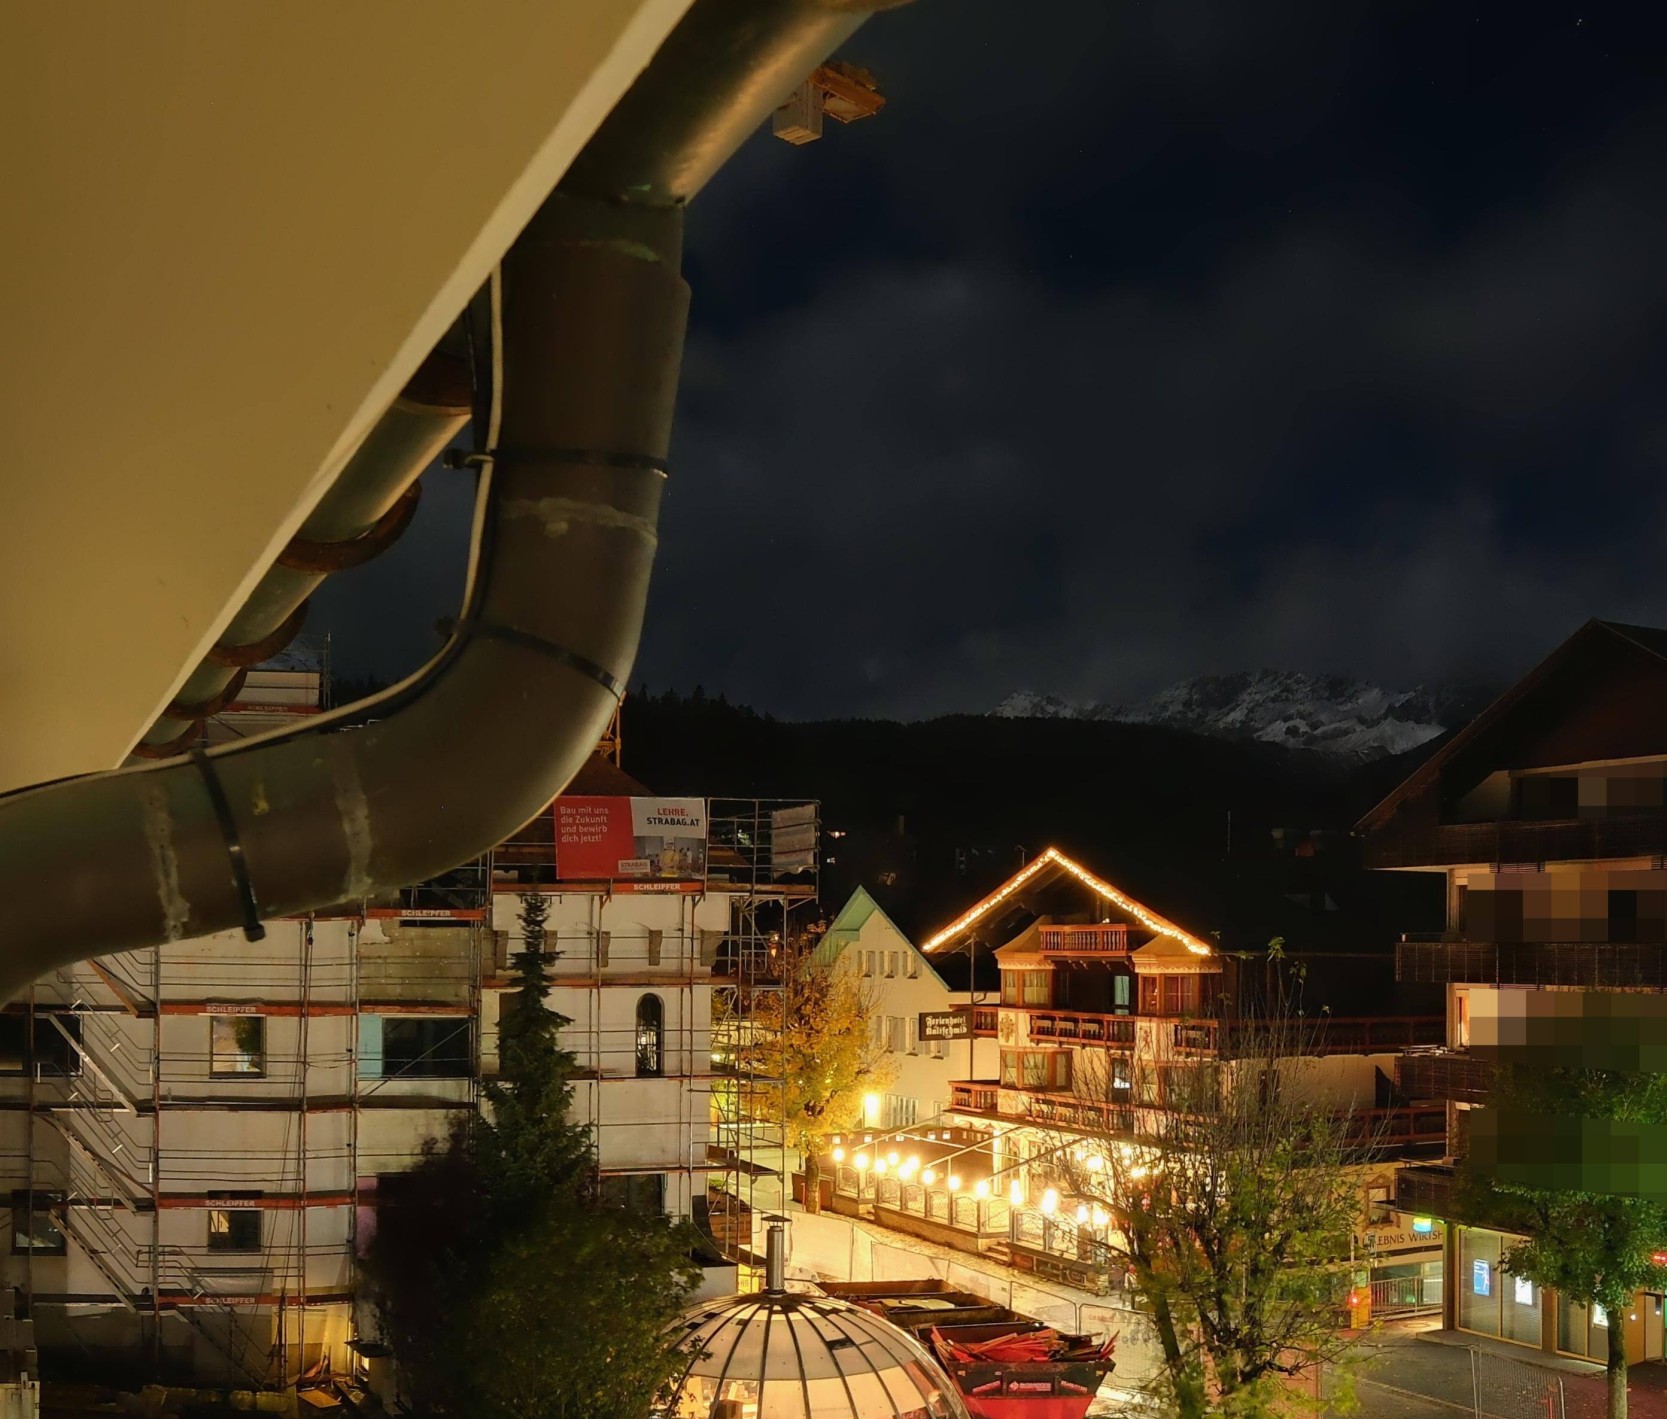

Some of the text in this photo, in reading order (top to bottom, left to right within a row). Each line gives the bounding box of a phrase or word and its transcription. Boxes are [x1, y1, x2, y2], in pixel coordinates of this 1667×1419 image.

[560, 806, 609, 815] Bau mit uns
[657, 807, 689, 817] LEHRE.
[561, 815, 607, 824] die Zukunft
[647, 817, 700, 827] STRABAG.AT
[561, 825, 608, 833] und bewirb
[562, 834, 602, 844] dich jetzt!
[633, 883, 681, 891] SCHLEIPFER
[401, 909, 451, 917] SCHLEIPFER
